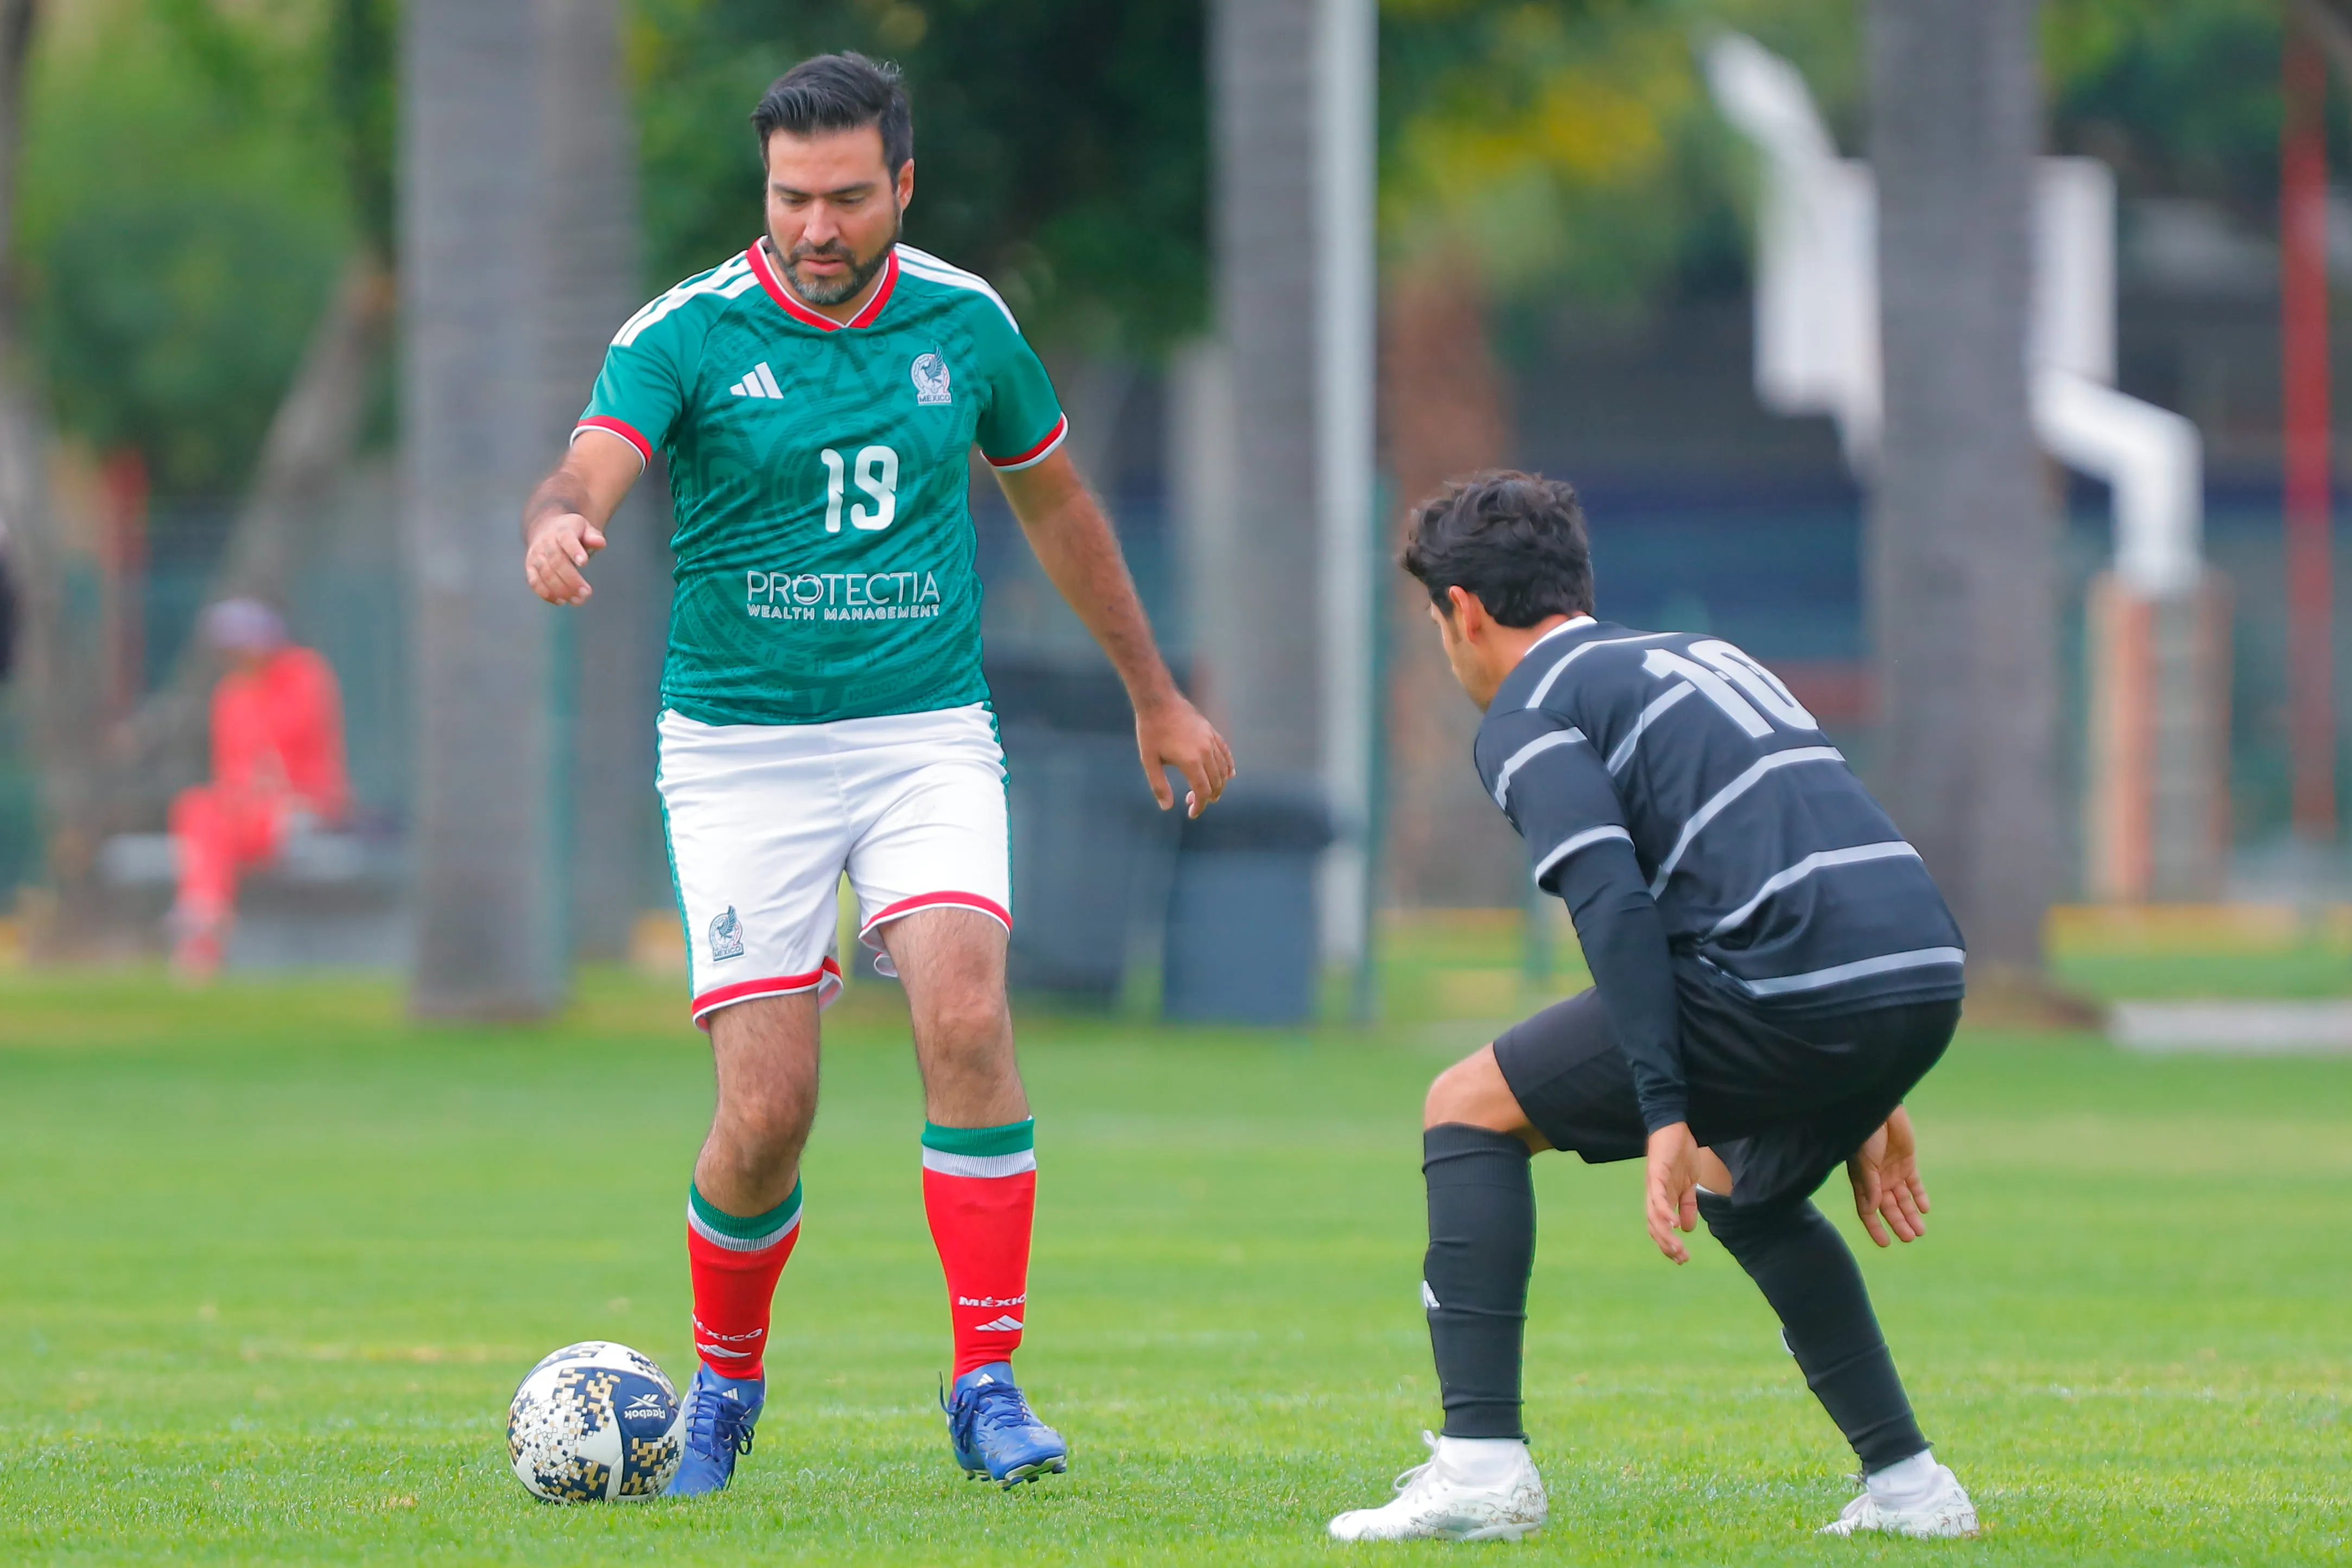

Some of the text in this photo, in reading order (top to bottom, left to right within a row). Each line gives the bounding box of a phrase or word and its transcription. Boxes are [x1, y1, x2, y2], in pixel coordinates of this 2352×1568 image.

[821, 445, 899, 533] 19
[747, 570, 940, 605] PROTECTIA
[747, 604, 940, 620] WEALTH MANAGEMENT
[1641, 639, 1820, 738] 10
[959, 1294, 1026, 1307] MÉXIC
[624, 1407, 665, 1420] Reebok
